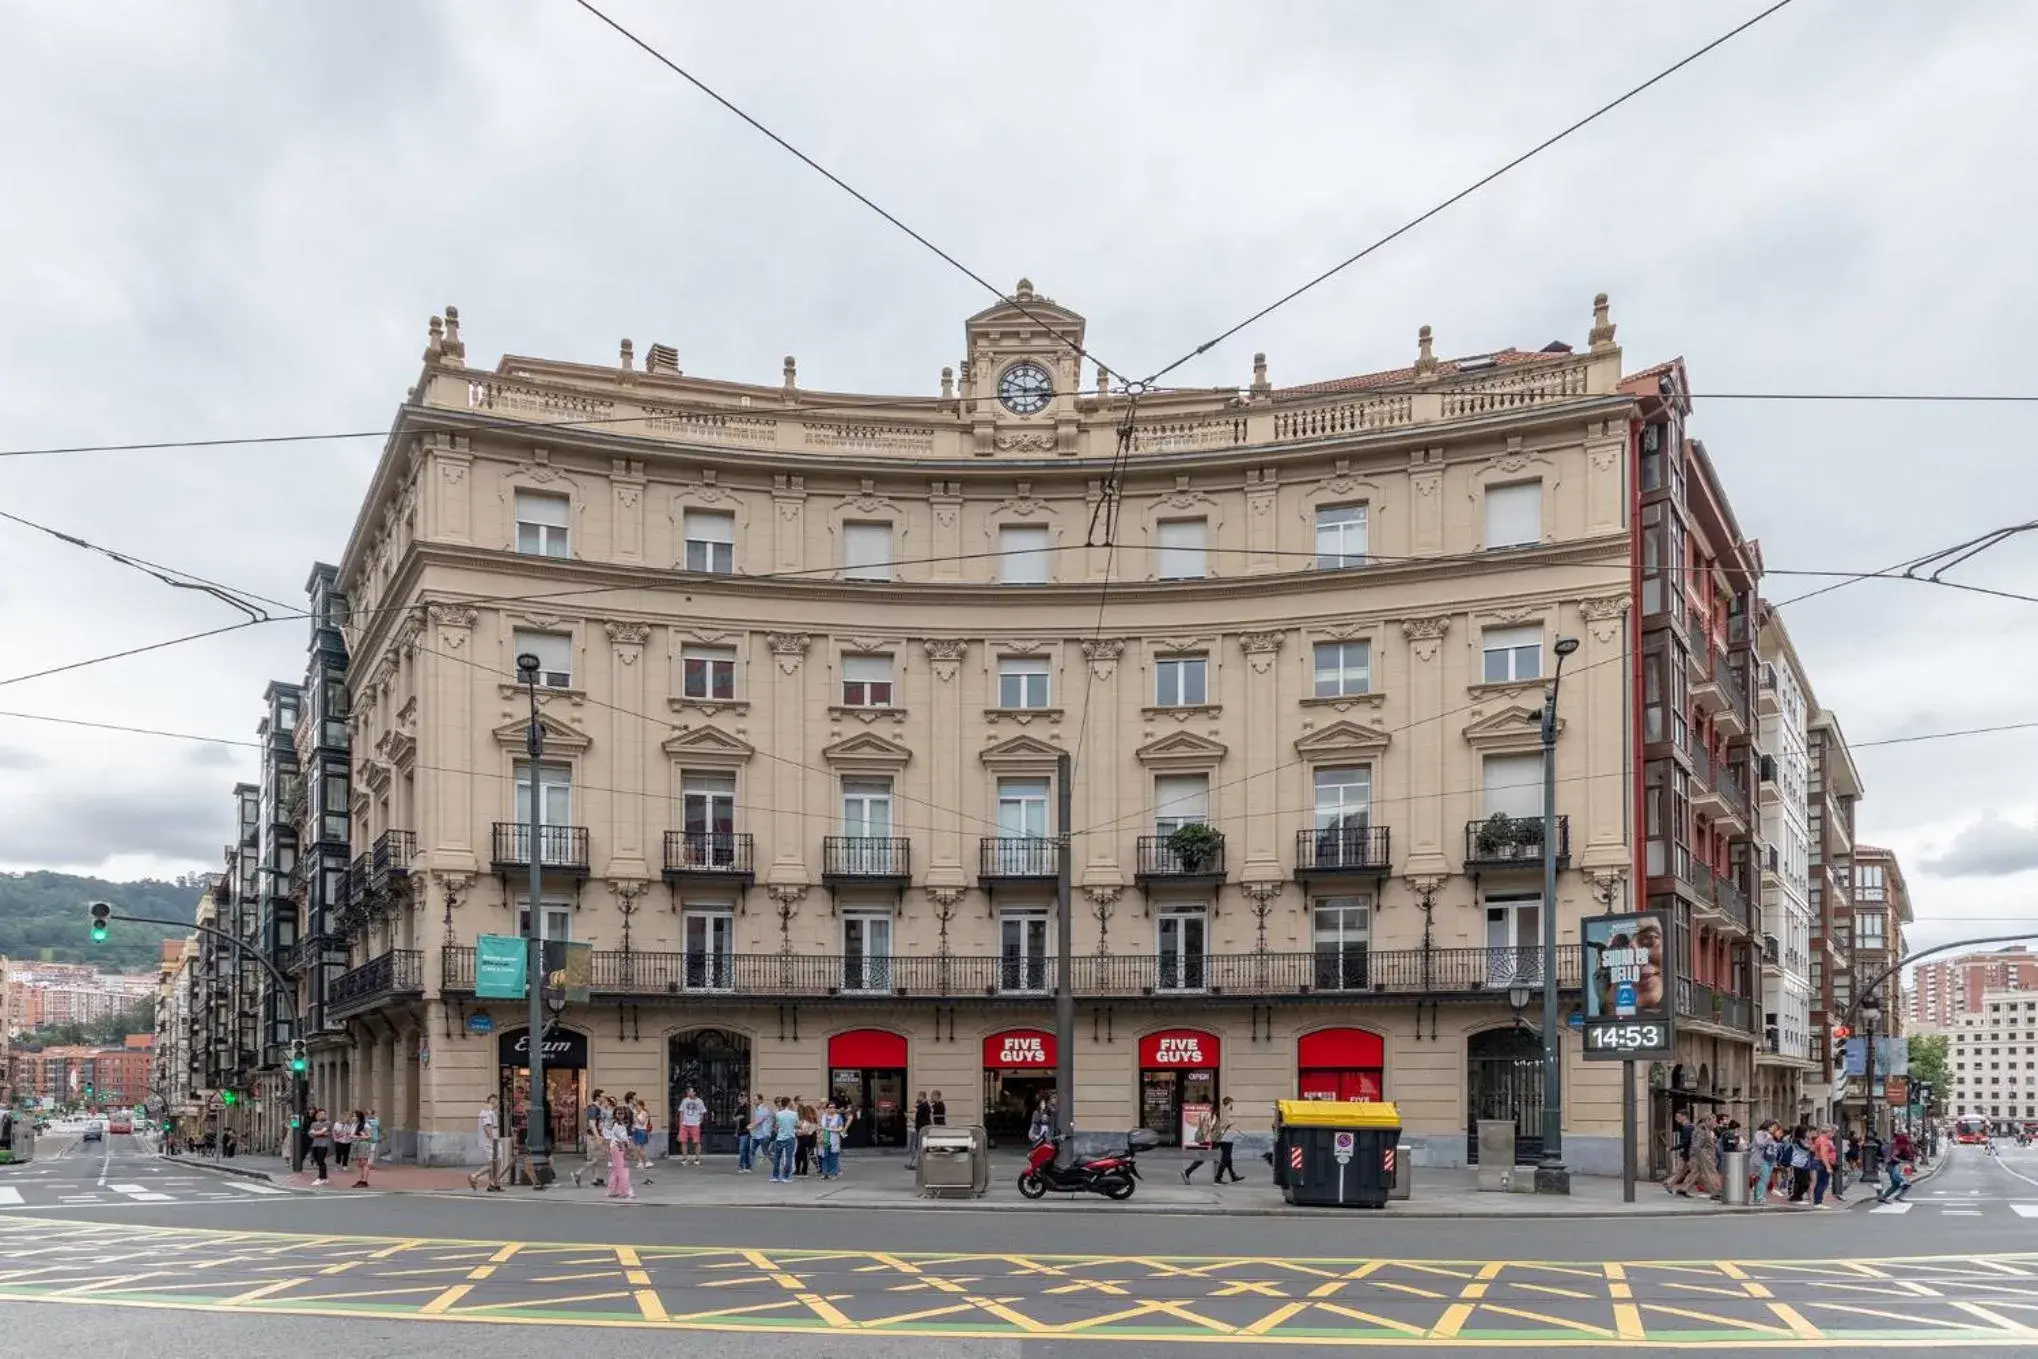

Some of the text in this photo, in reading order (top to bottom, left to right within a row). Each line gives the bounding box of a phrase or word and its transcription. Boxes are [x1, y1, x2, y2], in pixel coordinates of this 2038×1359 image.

[1592, 1025, 1659, 1048] 14:53
[514, 1035, 572, 1052] Eam
[1004, 1038, 1041, 1050] FIVE
[1160, 1038, 1198, 1050] FIVE
[1000, 1050, 1046, 1062] GUYS
[1156, 1050, 1203, 1063] GUYS
